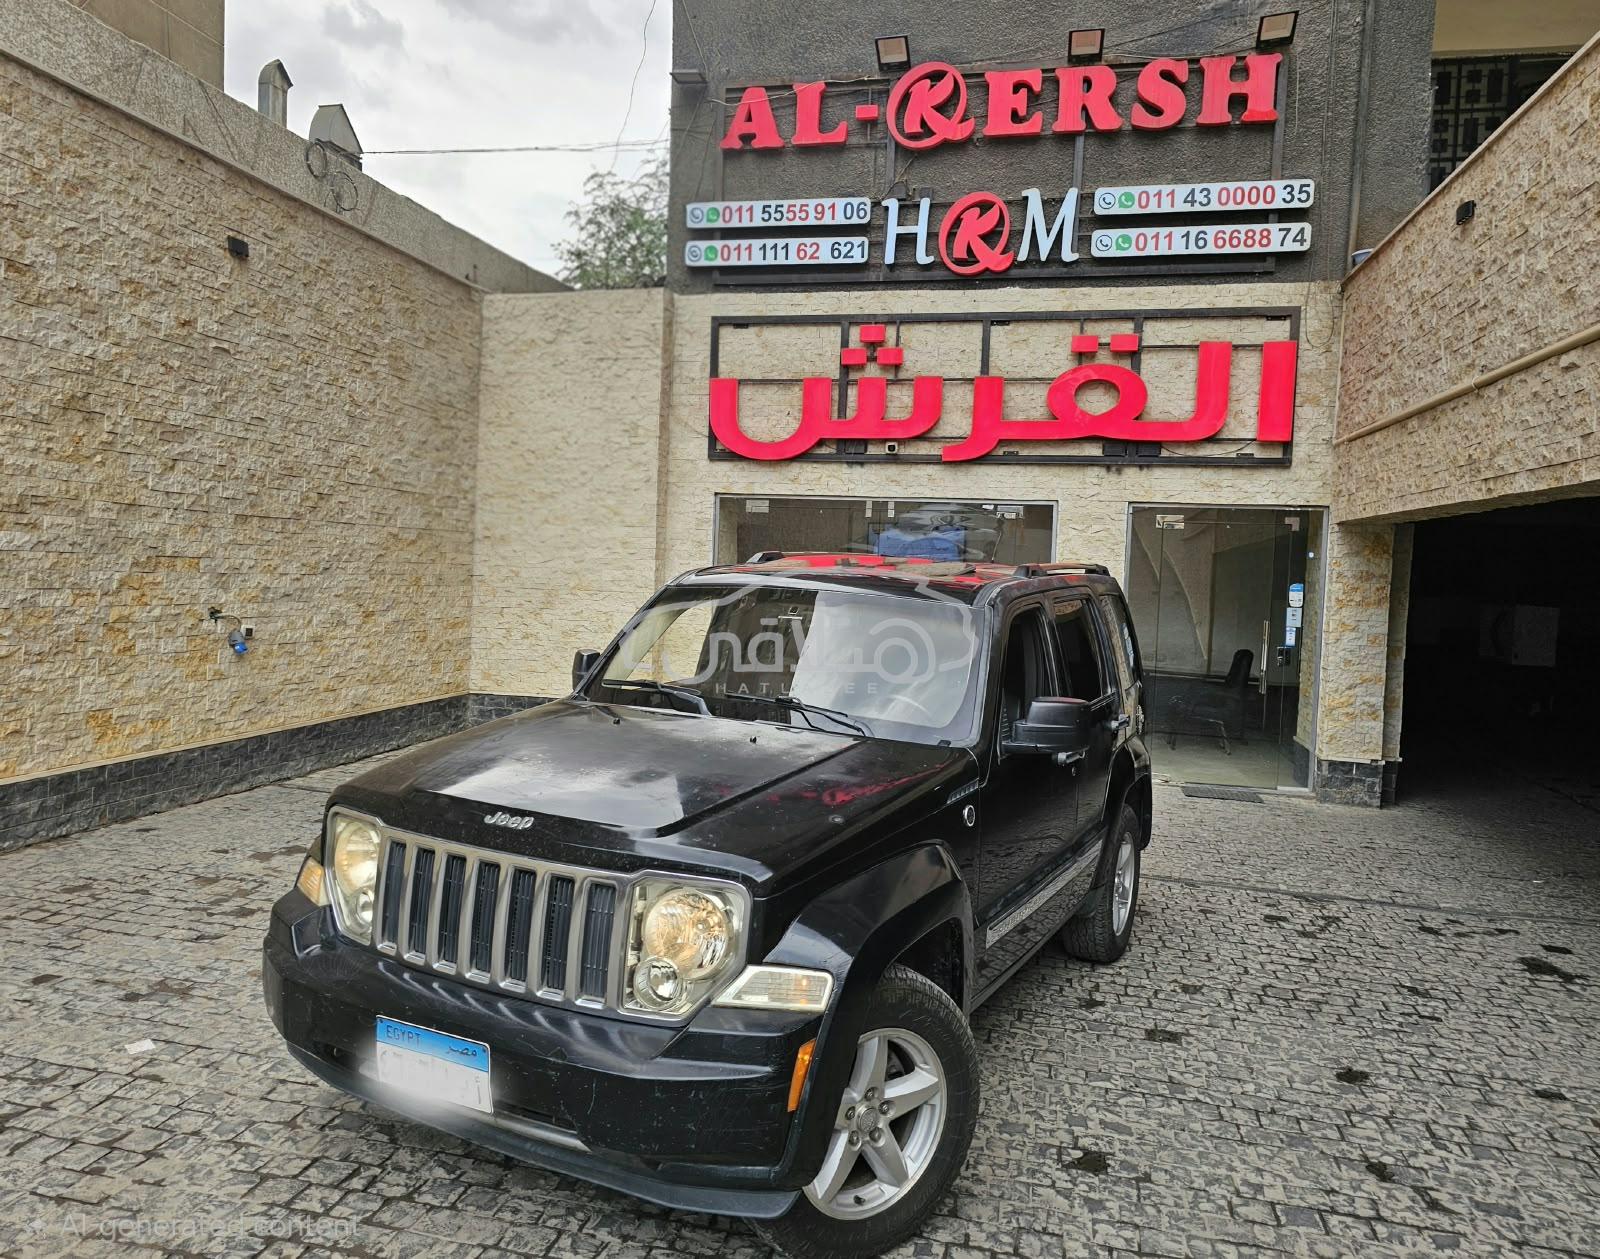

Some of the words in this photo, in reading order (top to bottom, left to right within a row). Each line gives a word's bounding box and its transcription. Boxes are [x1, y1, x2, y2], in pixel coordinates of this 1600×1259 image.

[1137, 188, 1176, 209] 011
[1183, 187, 1211, 207] 43
[1217, 184, 1276, 206] 0000
[1281, 183, 1311, 204] 35
[722, 205, 754, 224] 011
[843, 202, 868, 220] 06
[1135, 231, 1173, 251] 011
[1181, 230, 1208, 249] 16
[1213, 228, 1272, 249] 6688
[1278, 227, 1307, 246] 74
[720, 243, 753, 262] 011
[758, 242, 789, 260] 111
[796, 242, 820, 260] 62
[830, 240, 866, 259] 621
[709, 323, 1298, 461] القرش
[484, 811, 534, 830] Jeep
[386, 1025, 421, 1047] EGYPT
[446, 1045, 478, 1057] مصر
